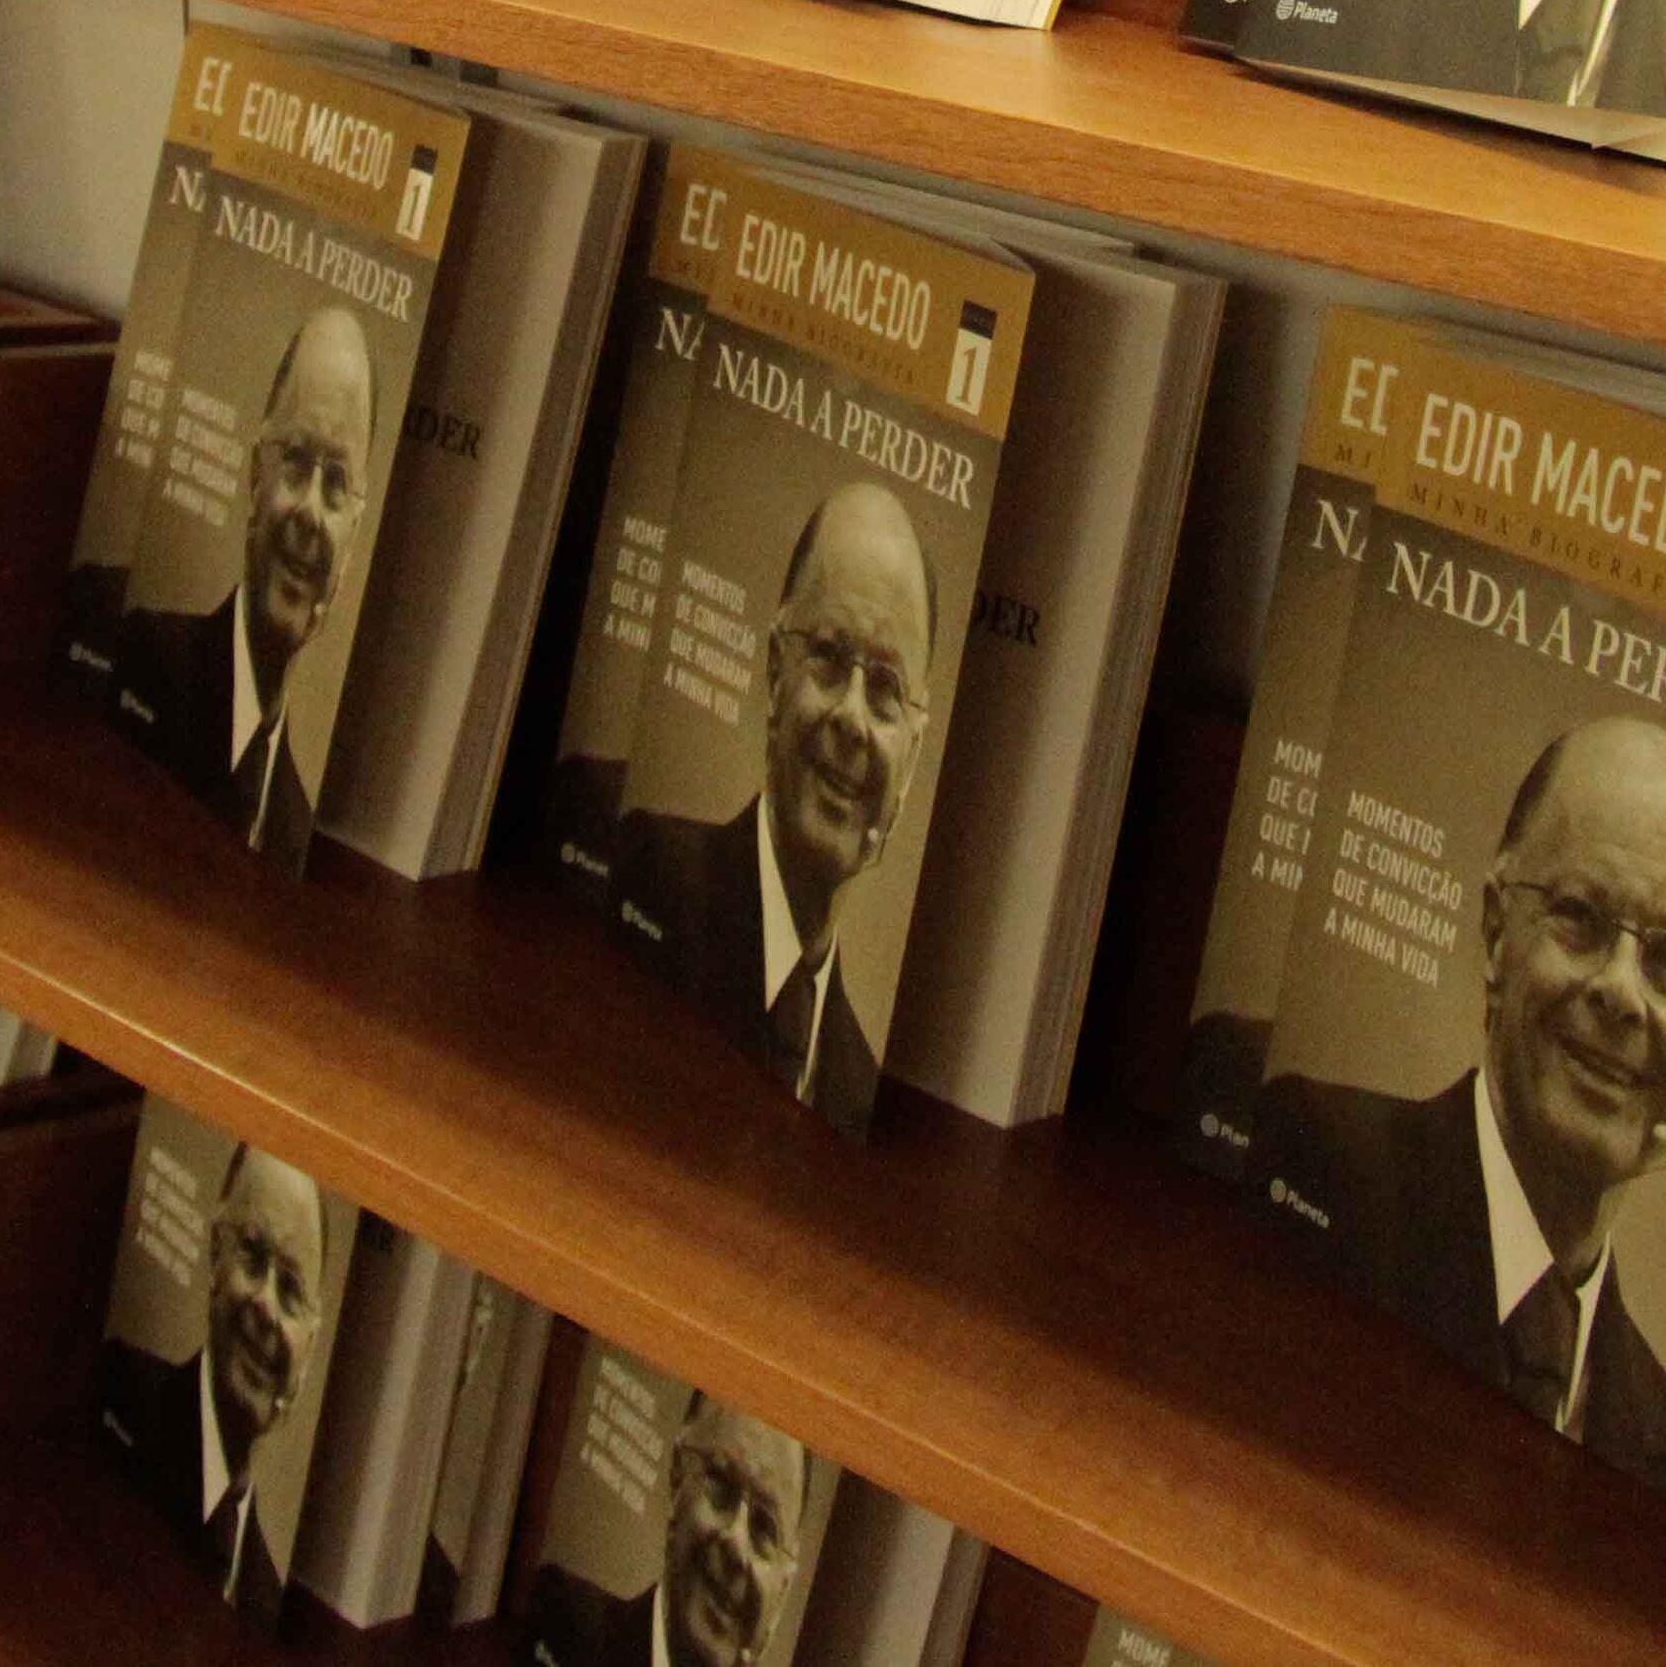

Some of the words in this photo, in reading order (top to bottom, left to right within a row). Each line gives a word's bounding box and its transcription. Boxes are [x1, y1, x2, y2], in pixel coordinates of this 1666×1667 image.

[1294, 0, 1339, 24] Planeta
[238, 82, 302, 155] EDIR
[300, 101, 397, 192] MACEDO
[405, 182, 423, 237] 1
[214, 195, 293, 268] NADA
[294, 233, 315, 276] A
[317, 242, 414, 324] PERDER
[735, 214, 807, 299] EDIR
[809, 240, 933, 352] MACEDO
[957, 345, 978, 406] 1
[713, 343, 807, 428] NADA
[811, 390, 833, 442] A
[838, 400, 974, 511] PERDER
[1415, 392, 1523, 496] EDIR
[1410, 484, 1510, 537] MINHA
[1387, 541, 1533, 648] NADA
[1538, 604, 1576, 668] A
[1267, 777, 1293, 810] DE
[1347, 790, 1446, 859] MOMENTOS
[1251, 852, 1265, 880] A
[1260, 814, 1299, 851] QUE
[1339, 829, 1365, 864] DE
[1333, 869, 1369, 906] QUE
[1370, 886, 1458, 953] MUDARAM
[1323, 907, 1337, 935] A
[1342, 914, 1396, 966] MINHA
[1401, 944, 1439, 988] VIDA
